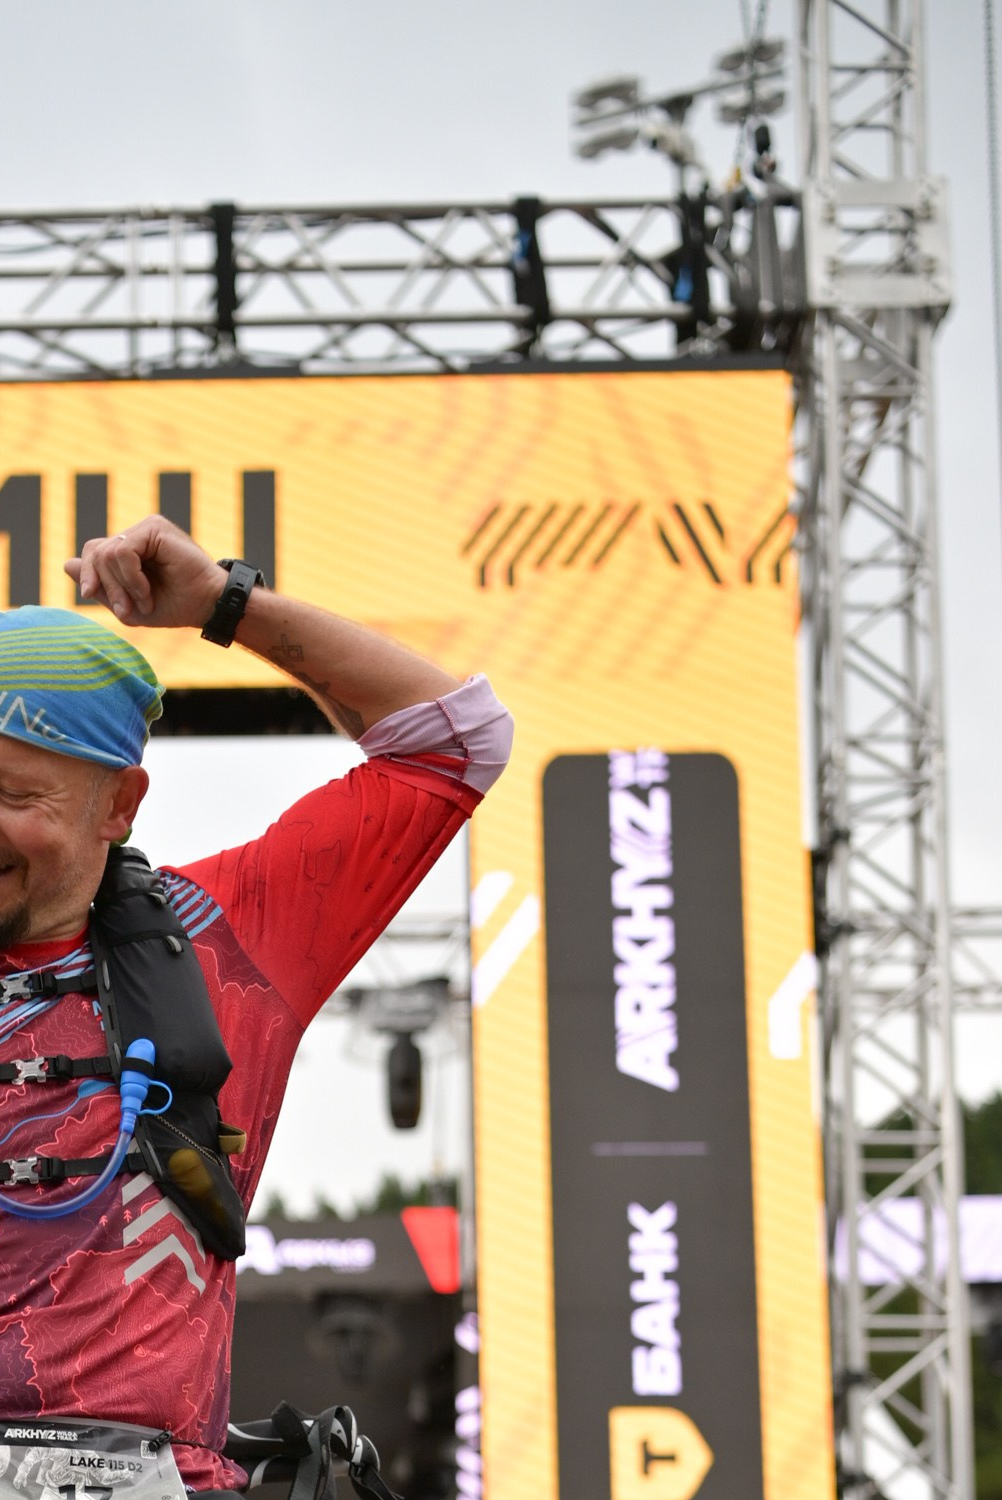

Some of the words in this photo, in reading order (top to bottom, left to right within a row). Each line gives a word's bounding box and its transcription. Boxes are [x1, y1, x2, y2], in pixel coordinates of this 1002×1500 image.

[610, 786, 680, 1092] ARKHYZ
[628, 1200, 682, 1396] БАНК
[4, 1428, 56, 1440] ARKHYZ
[70, 1456, 105, 1468] LAKE
[108, 1460, 124, 1470] 115
[128, 1462, 143, 1473] D2
